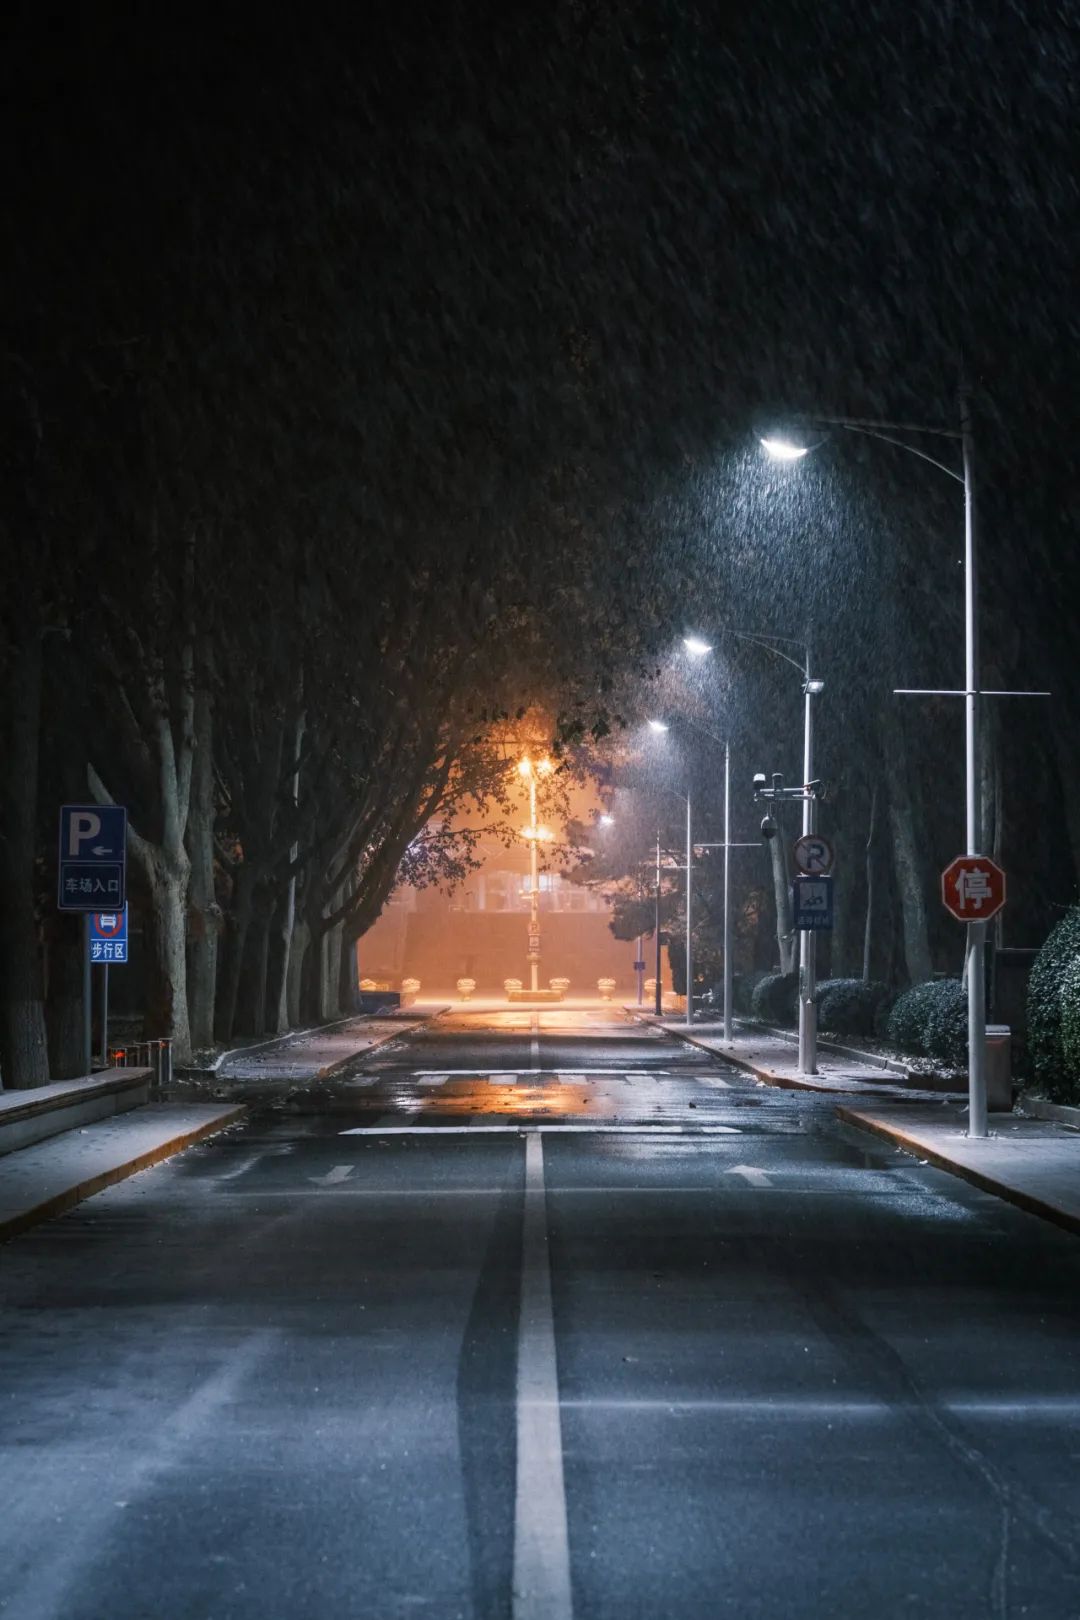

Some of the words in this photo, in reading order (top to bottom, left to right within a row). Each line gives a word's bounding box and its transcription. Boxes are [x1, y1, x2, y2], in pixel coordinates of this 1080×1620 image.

[69, 811, 102, 856] P
[64, 877, 119, 894] 车场入口
[955, 867, 992, 910] 停
[92, 943, 125, 959] 步行区
